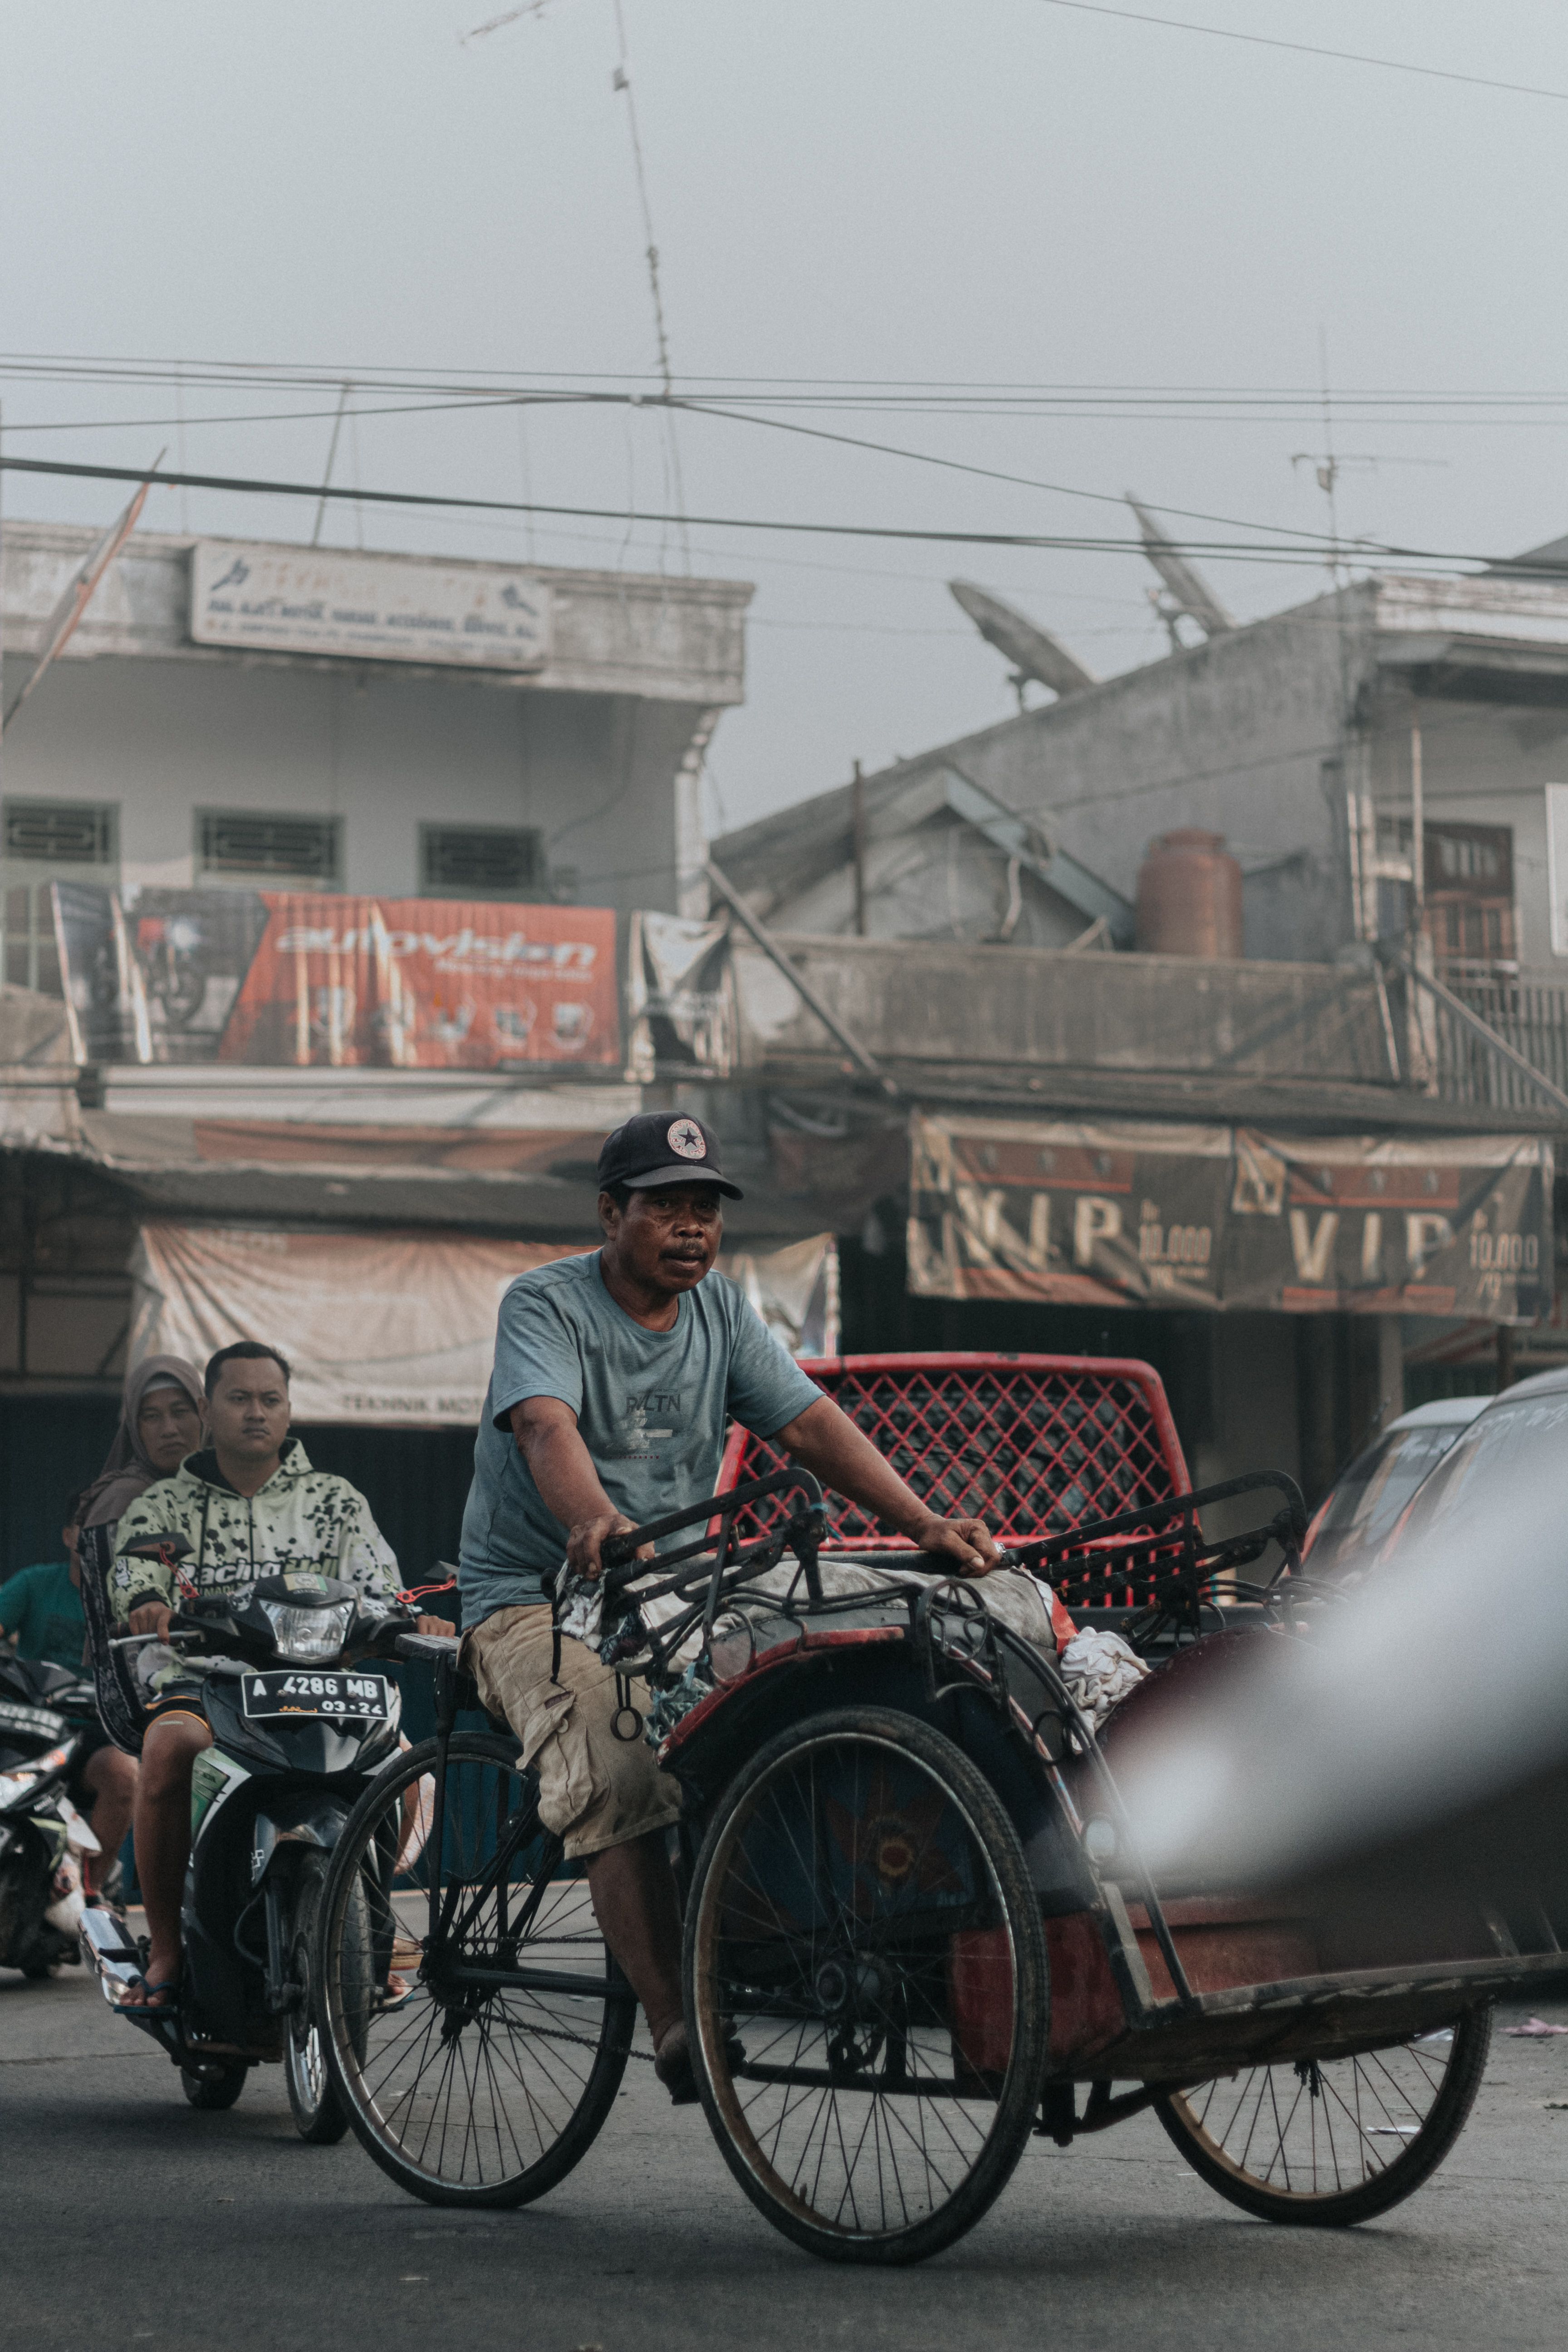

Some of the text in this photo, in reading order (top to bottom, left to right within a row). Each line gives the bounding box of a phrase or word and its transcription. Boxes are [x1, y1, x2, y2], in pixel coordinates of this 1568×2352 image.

[1289, 1208, 1454, 1281] VIP
[1470, 1231, 1539, 1272] 10.000
[437, 1396, 483, 1415] MOT
[174, 1559, 281, 1583] Racing
[253, 1676, 378, 1699] A 4286 MB
